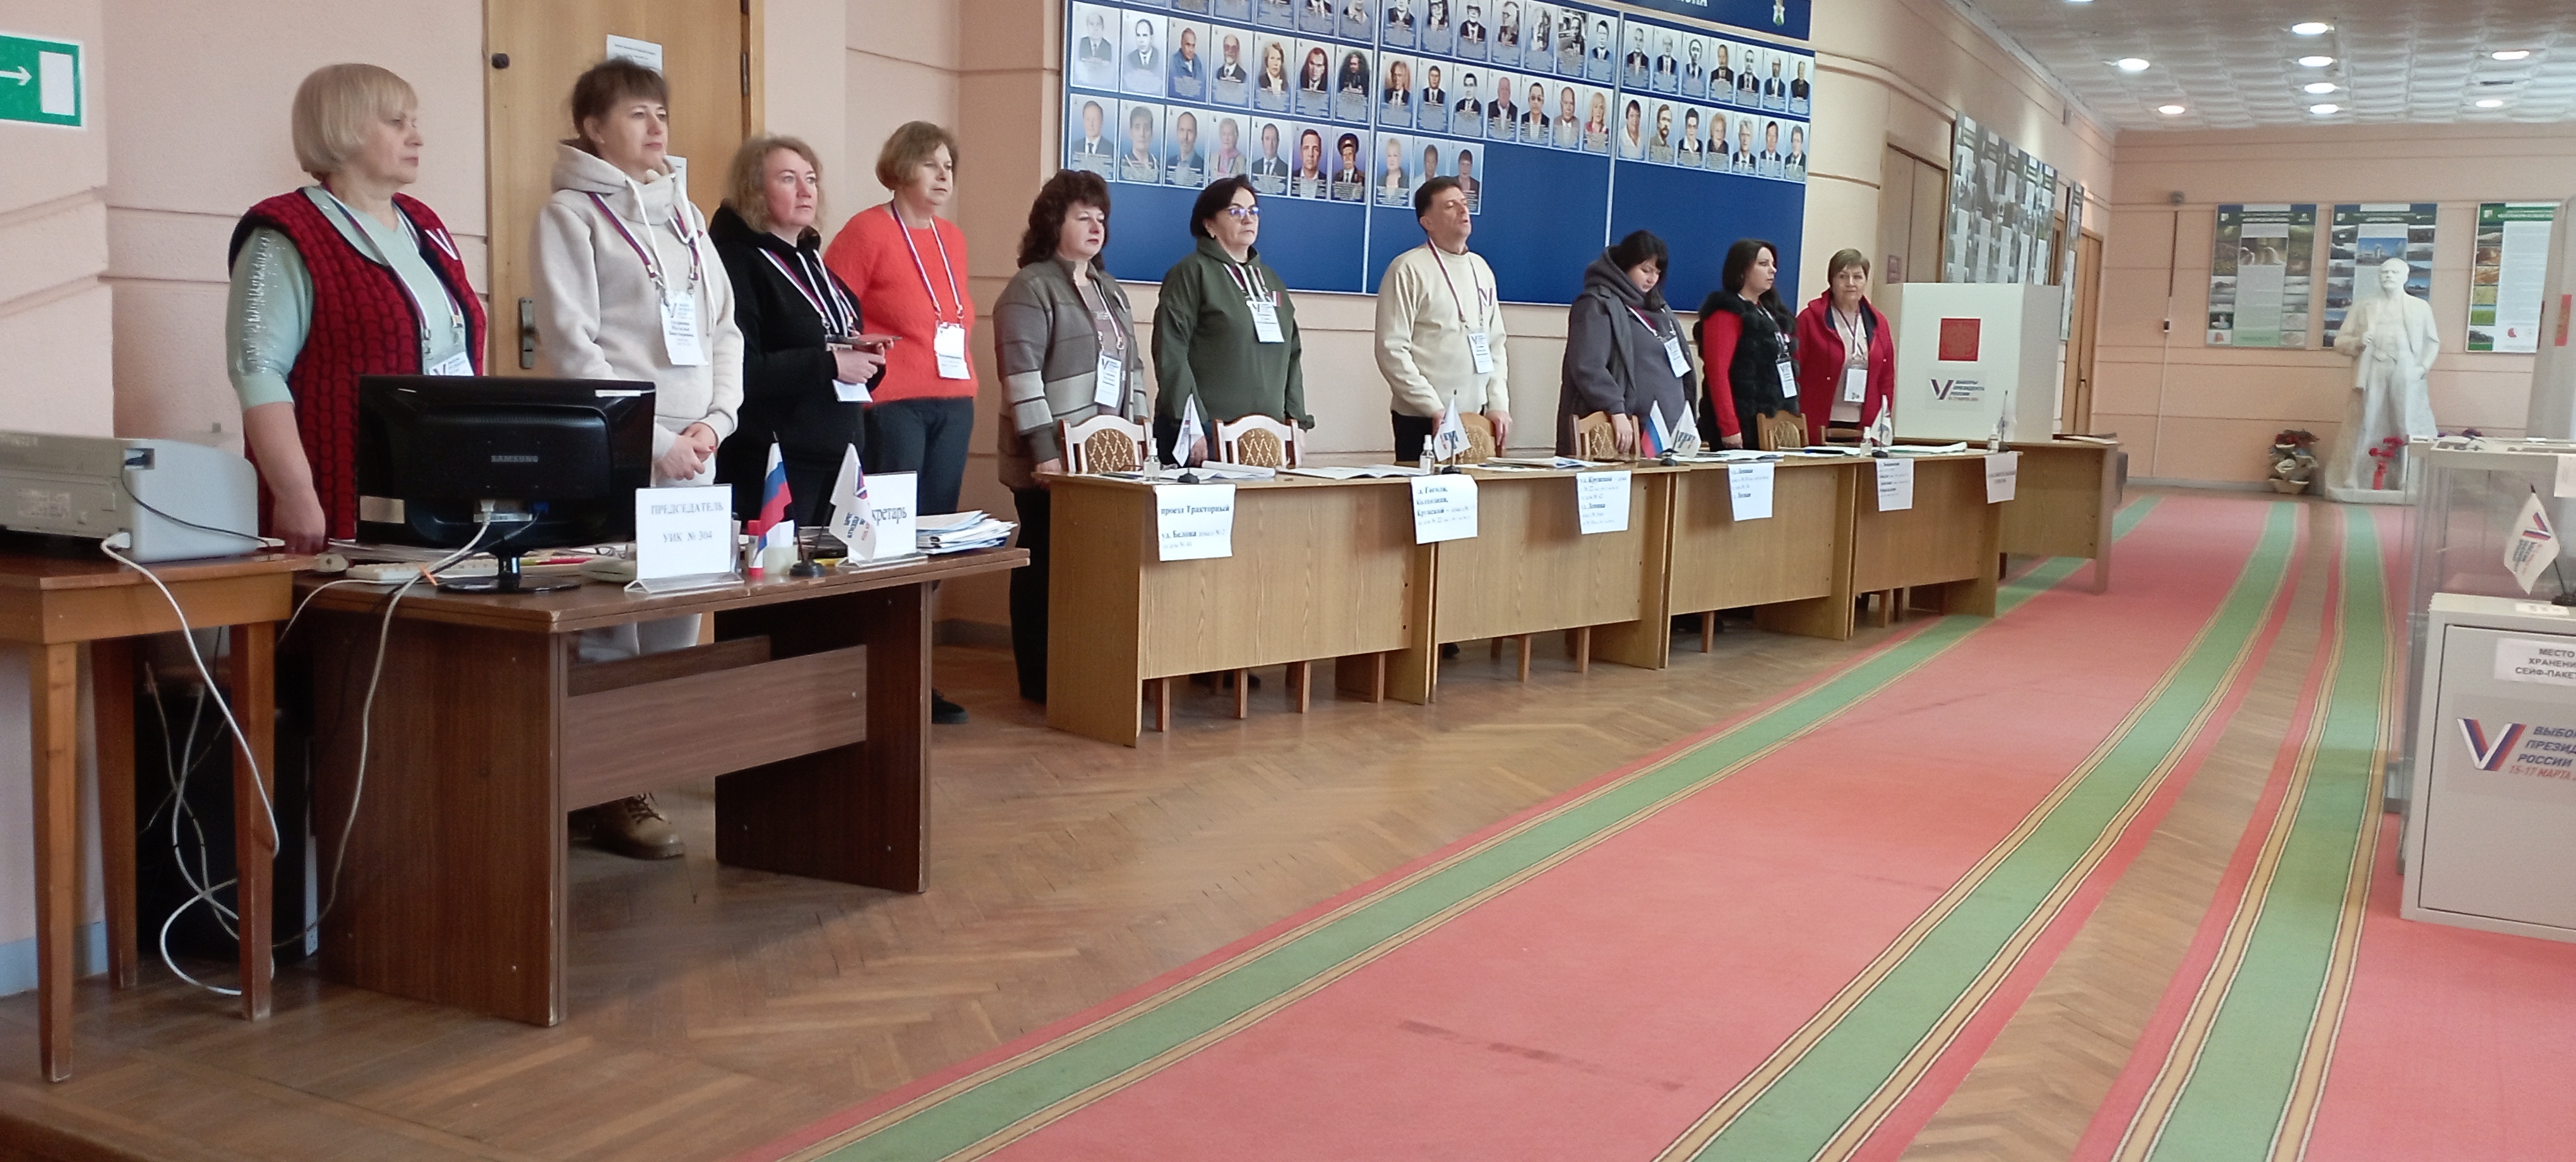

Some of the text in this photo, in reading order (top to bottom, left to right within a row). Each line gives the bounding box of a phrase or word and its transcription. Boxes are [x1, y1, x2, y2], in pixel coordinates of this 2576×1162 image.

[651, 502, 724, 514] ПРЕДСЕДАТЕЛЬ
[1186, 505, 1229, 515] Тракторный
[663, 532, 683, 542] УИК
[699, 531, 712, 540] 304
[2539, 648, 2575, 657] МЕСТО
[2517, 753, 2573, 767] РОССИИ
[2536, 767, 2570, 781] МАРТА
